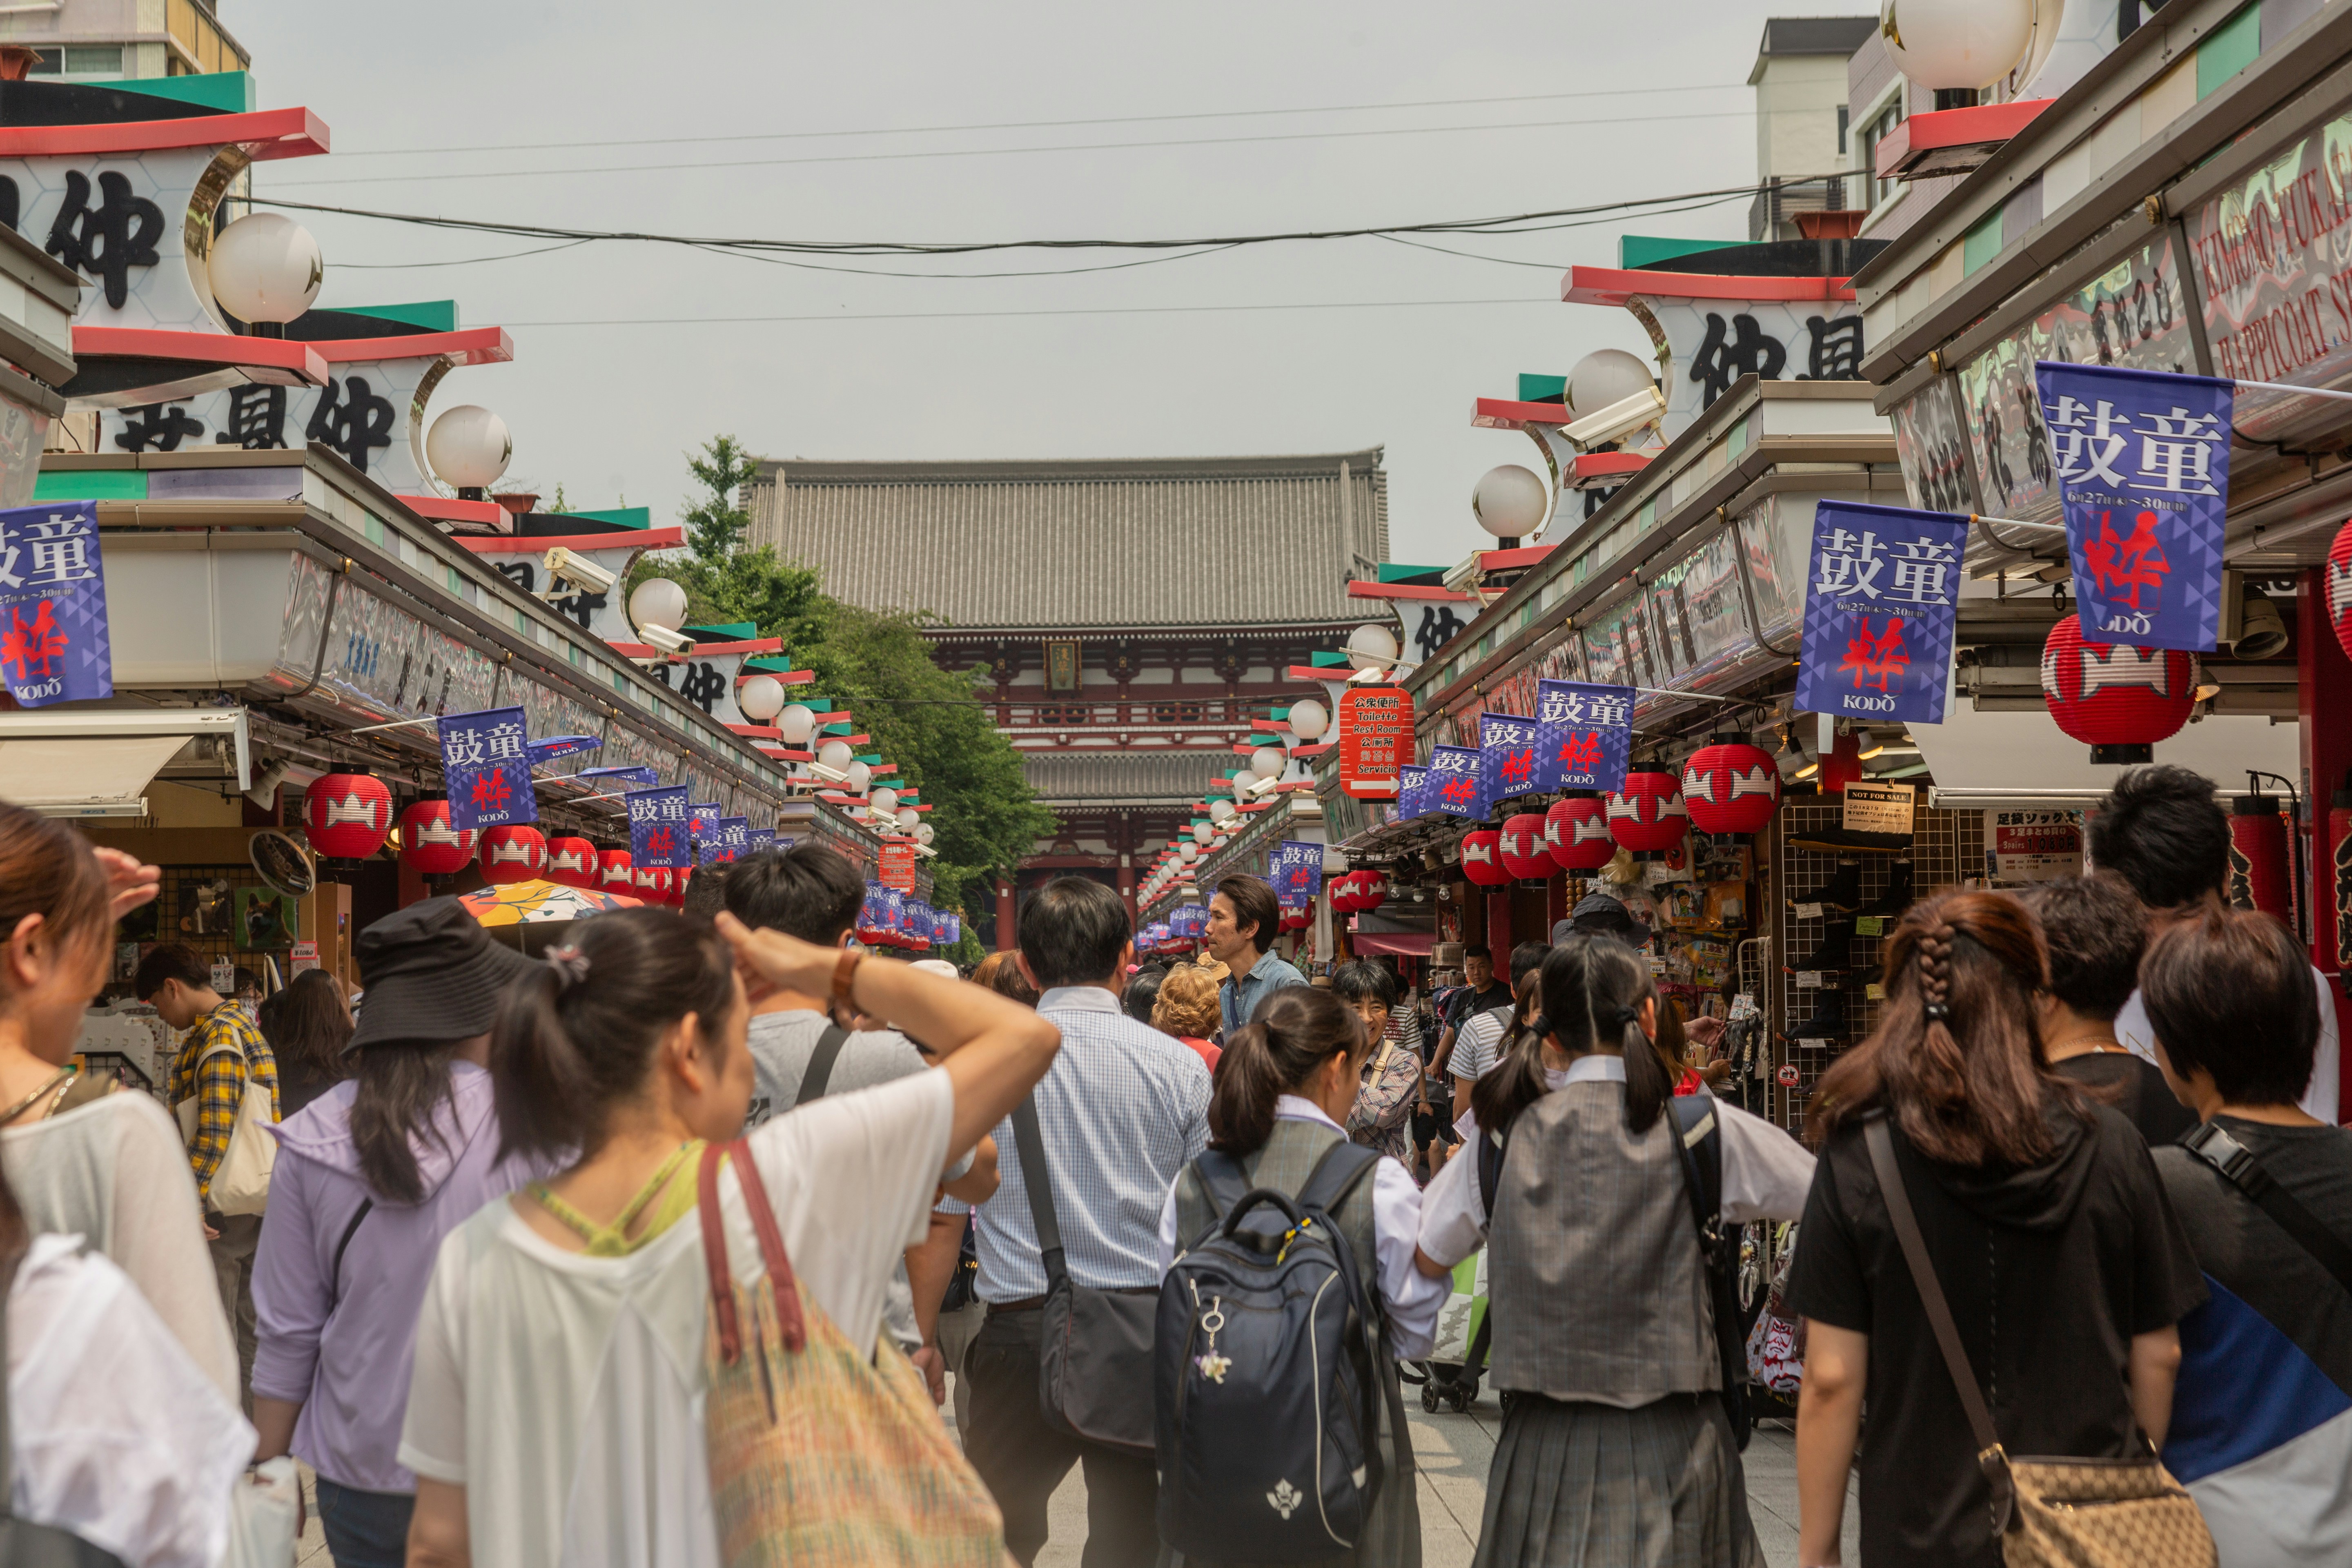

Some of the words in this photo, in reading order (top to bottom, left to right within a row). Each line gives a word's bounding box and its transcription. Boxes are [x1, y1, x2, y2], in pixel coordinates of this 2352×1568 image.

[2197, 201, 2275, 302] KIMONO
[2274, 144, 2352, 254] YUKAT
[2218, 287, 2329, 396] HAPPICOAT
[2044, 395, 2223, 496] 鼓童
[1815, 528, 1956, 606] 鼓童
[1699, 599, 1713, 624] Since
[1354, 697, 1399, 708] 公衆便所
[1541, 690, 1630, 728] 鼓童
[1354, 724, 1374, 733] Rest
[1377, 724, 1401, 733] Room
[1357, 712, 1397, 721] Toilette
[445, 723, 526, 767] 鼓童
[1361, 751, 1394, 762] 화장실
[1358, 764, 1397, 773] Servicio
[628, 796, 688, 822] 鼓童
[1283, 846, 1321, 865] 鼓童
[2003, 841, 2025, 850] 3pairs
